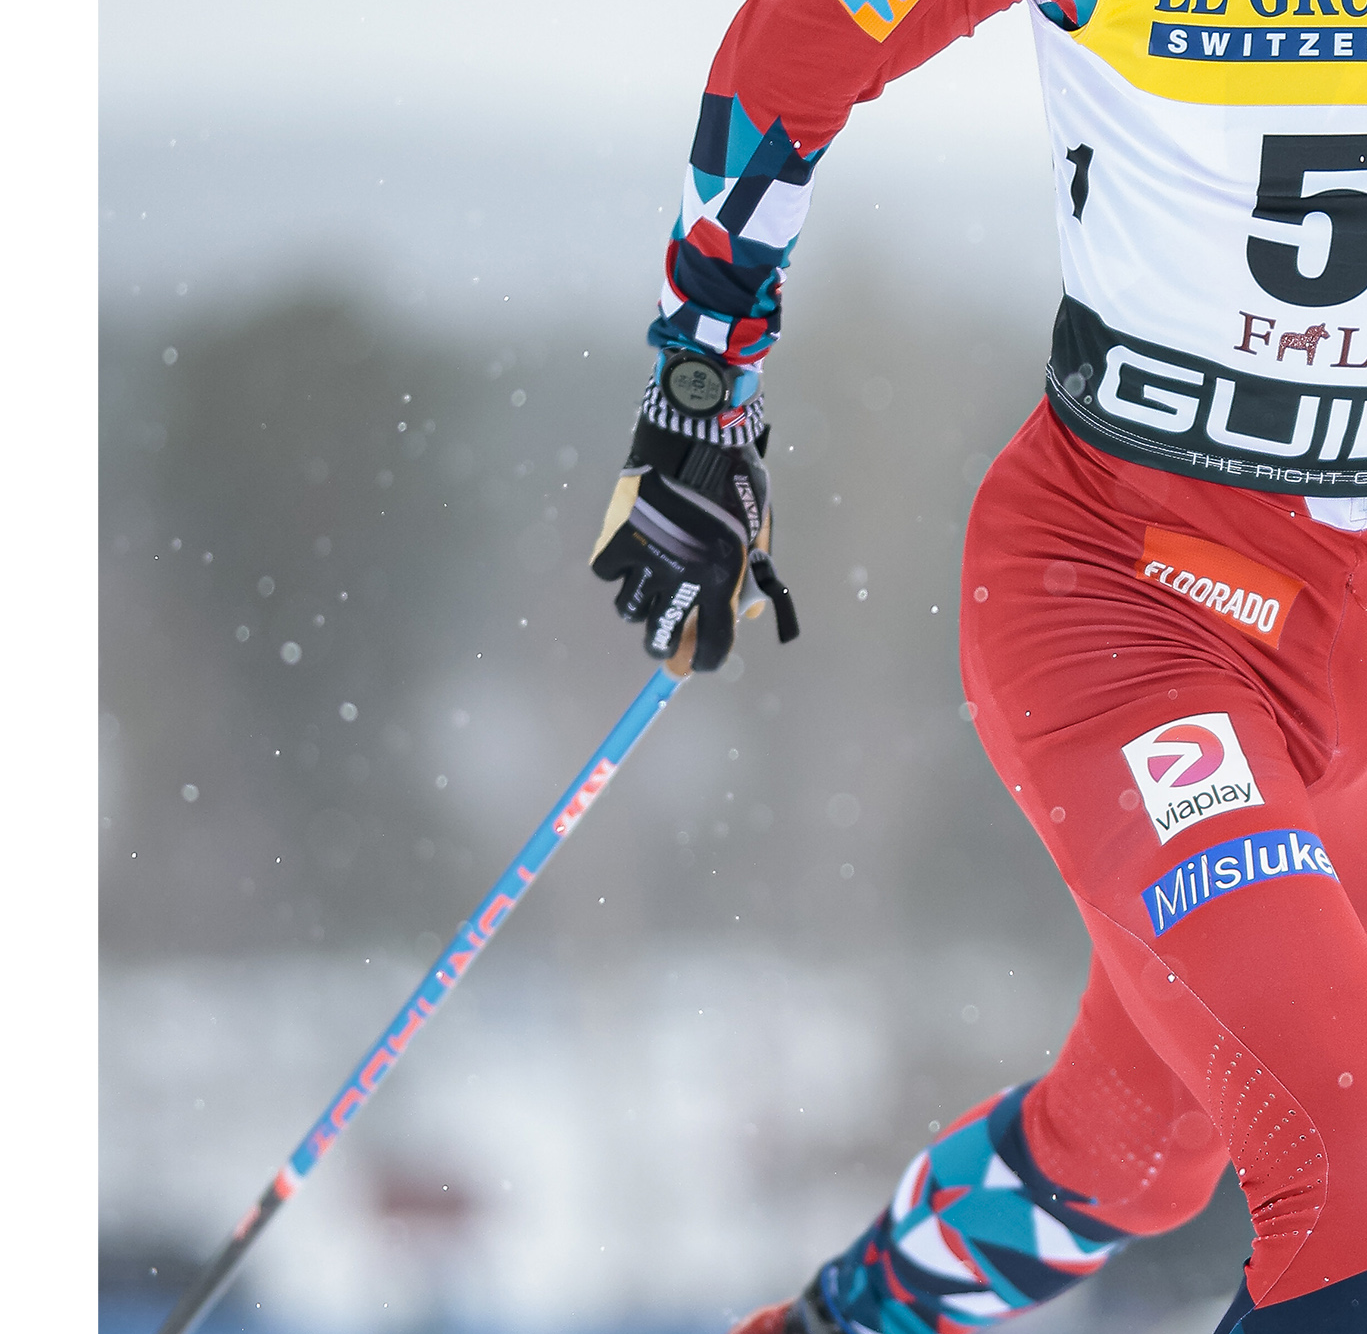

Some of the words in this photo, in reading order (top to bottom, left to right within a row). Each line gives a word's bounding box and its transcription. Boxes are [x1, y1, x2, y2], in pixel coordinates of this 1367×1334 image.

[1189, 451, 1243, 476] THE
[1255, 464, 1343, 486] RIGHT
[1144, 560, 1281, 634] ELDORADO
[1155, 780, 1253, 832] viaplay
[1153, 833, 1334, 932] Milsluke
